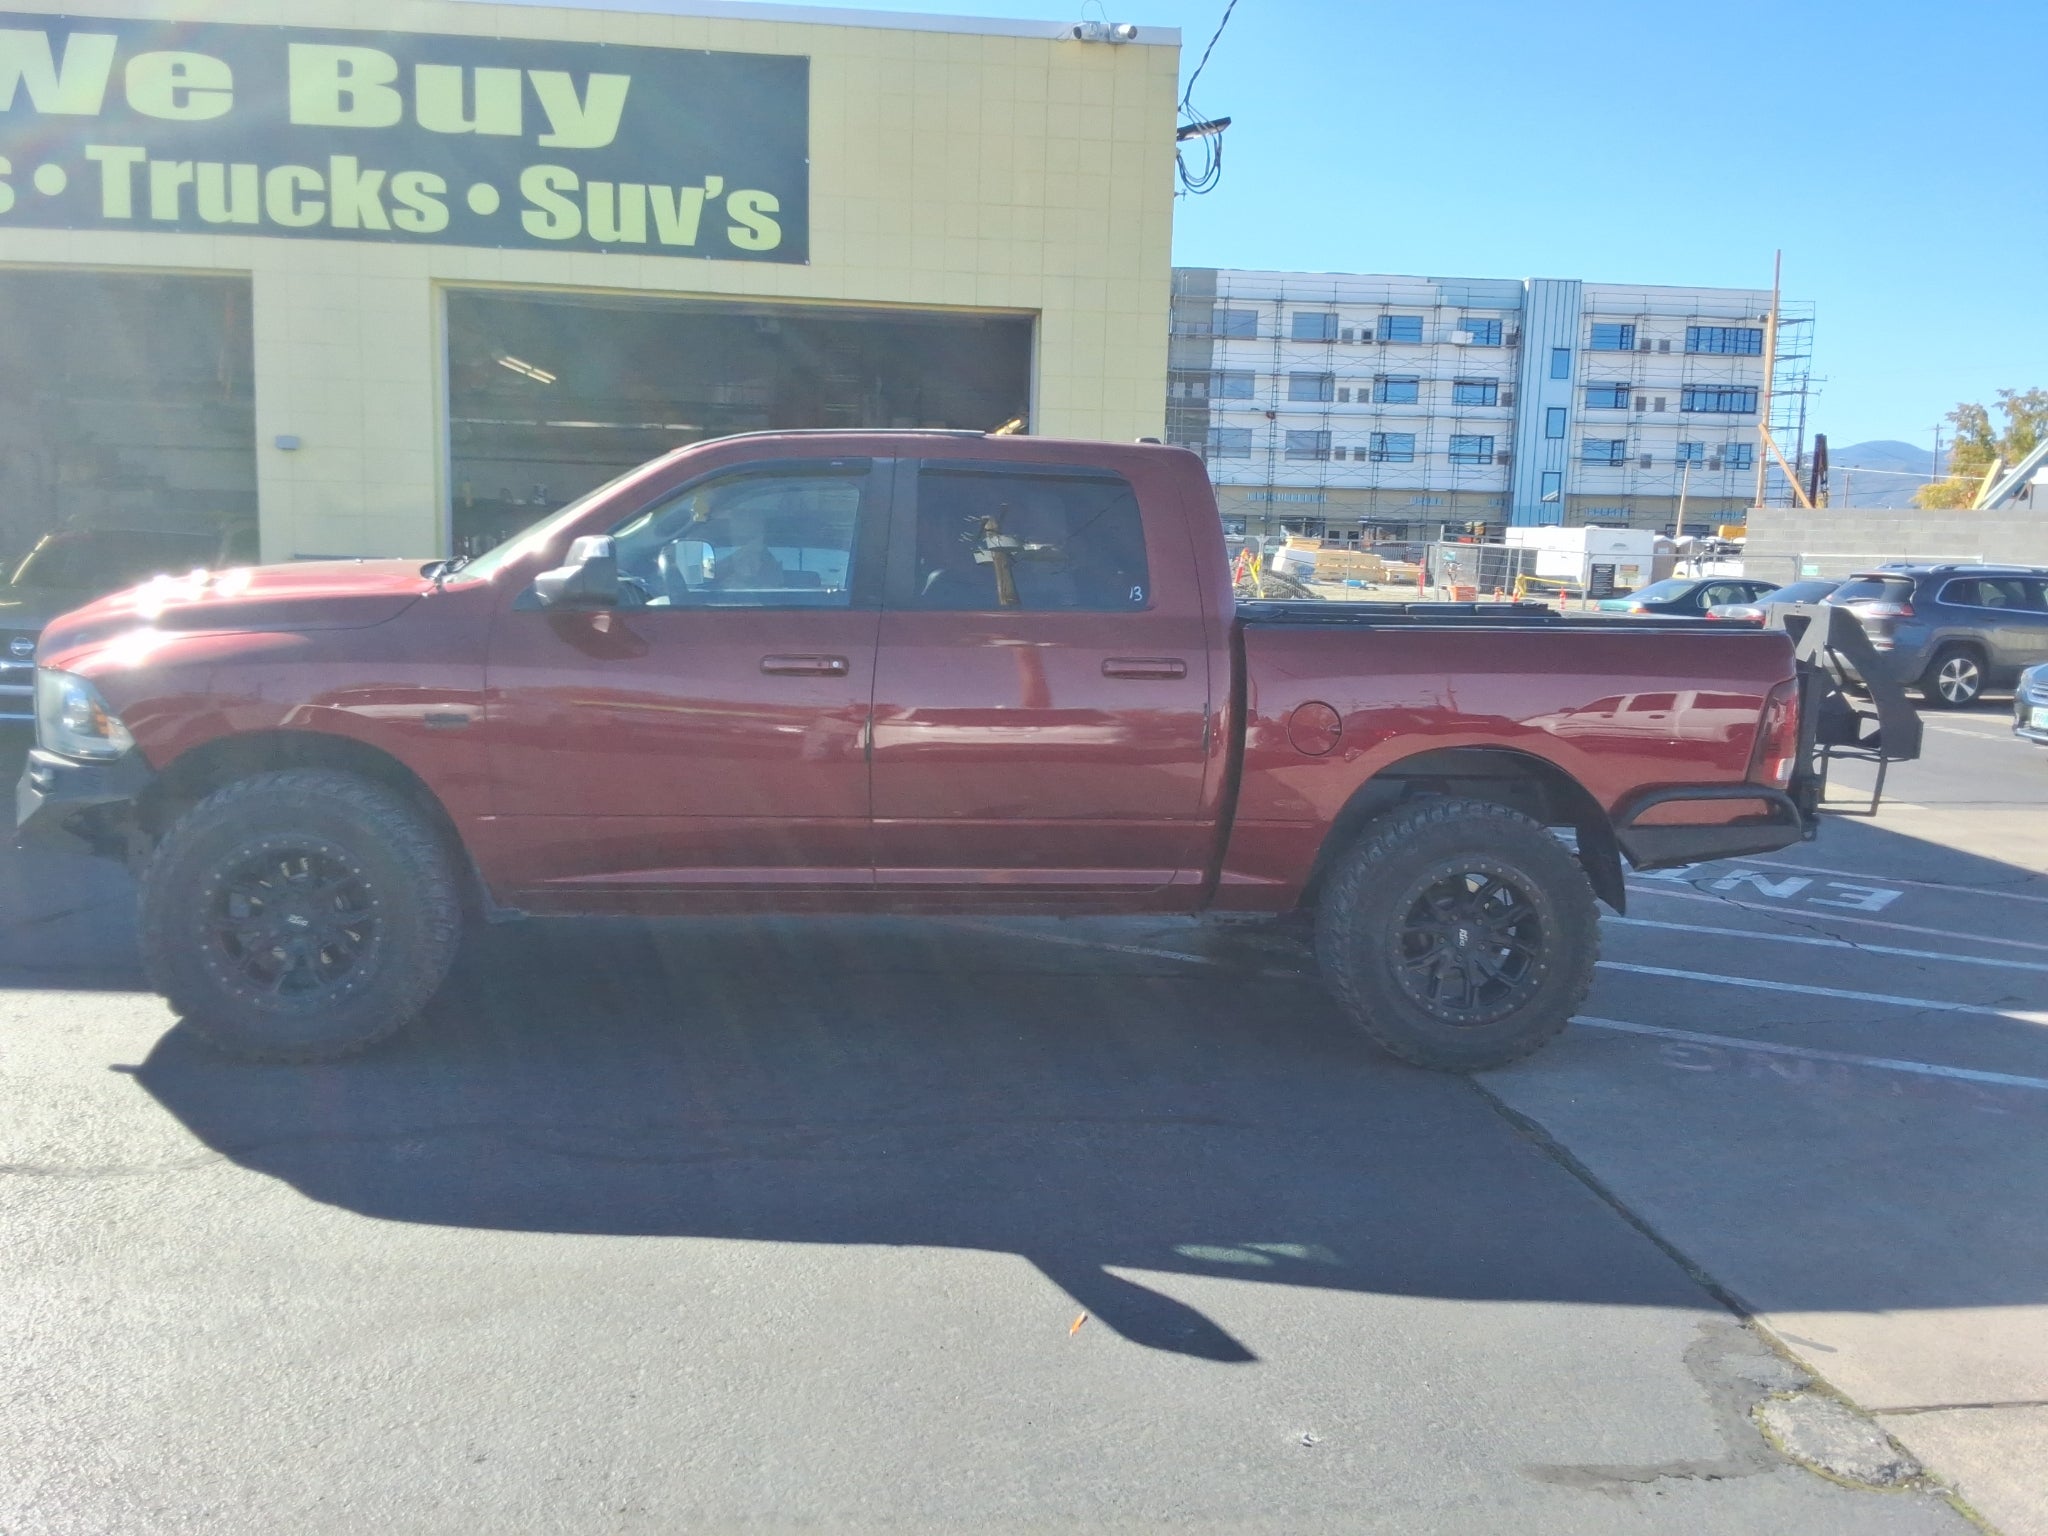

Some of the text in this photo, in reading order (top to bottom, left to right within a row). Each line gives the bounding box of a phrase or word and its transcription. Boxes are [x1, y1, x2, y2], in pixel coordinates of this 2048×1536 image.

[0, 28, 631, 149] We Buy
[85, 144, 449, 234] Trucks
[519, 164, 782, 251] Suv's
